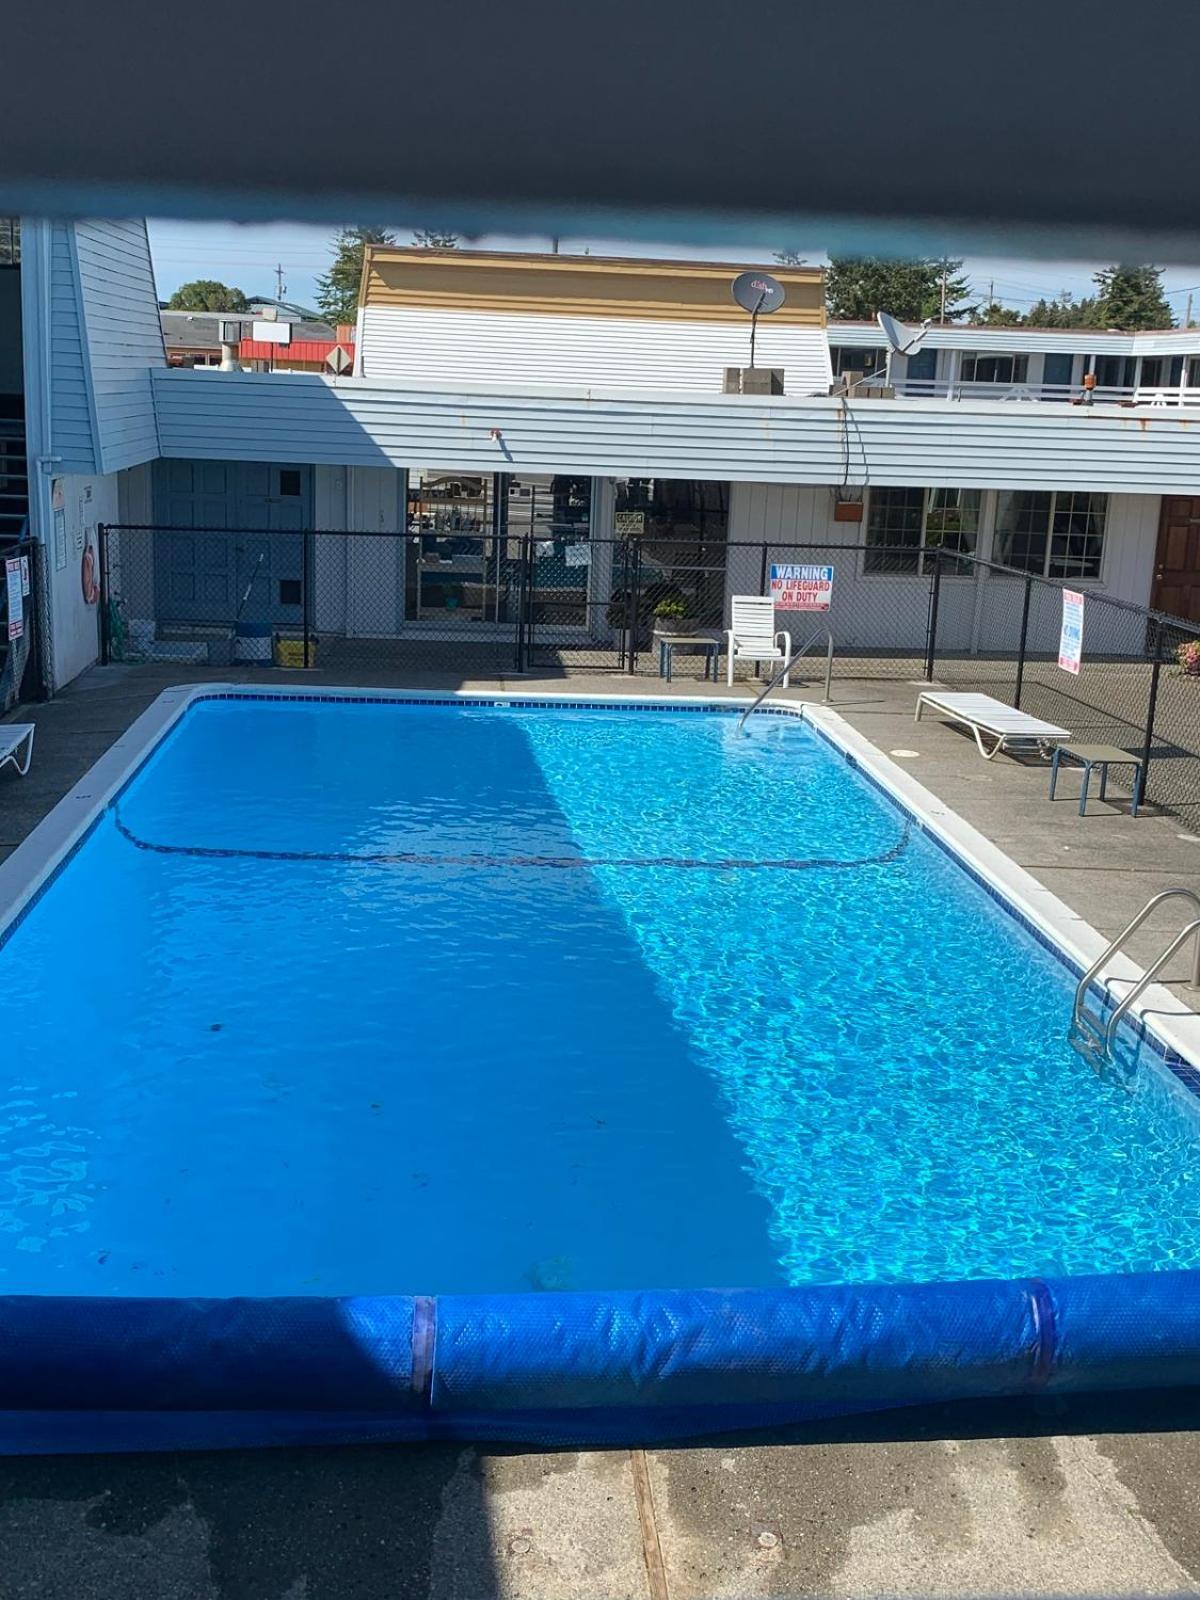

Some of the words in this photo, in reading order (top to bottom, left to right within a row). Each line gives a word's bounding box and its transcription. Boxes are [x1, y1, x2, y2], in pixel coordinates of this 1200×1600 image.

[617, 514, 642, 523] CAUON
[776, 566, 828, 579] WARNING
[772, 580, 783, 590] NO
[786, 580, 830, 591] LIFEGUARD
[782, 591, 793, 601] ON
[796, 592, 818, 602] DUTY
